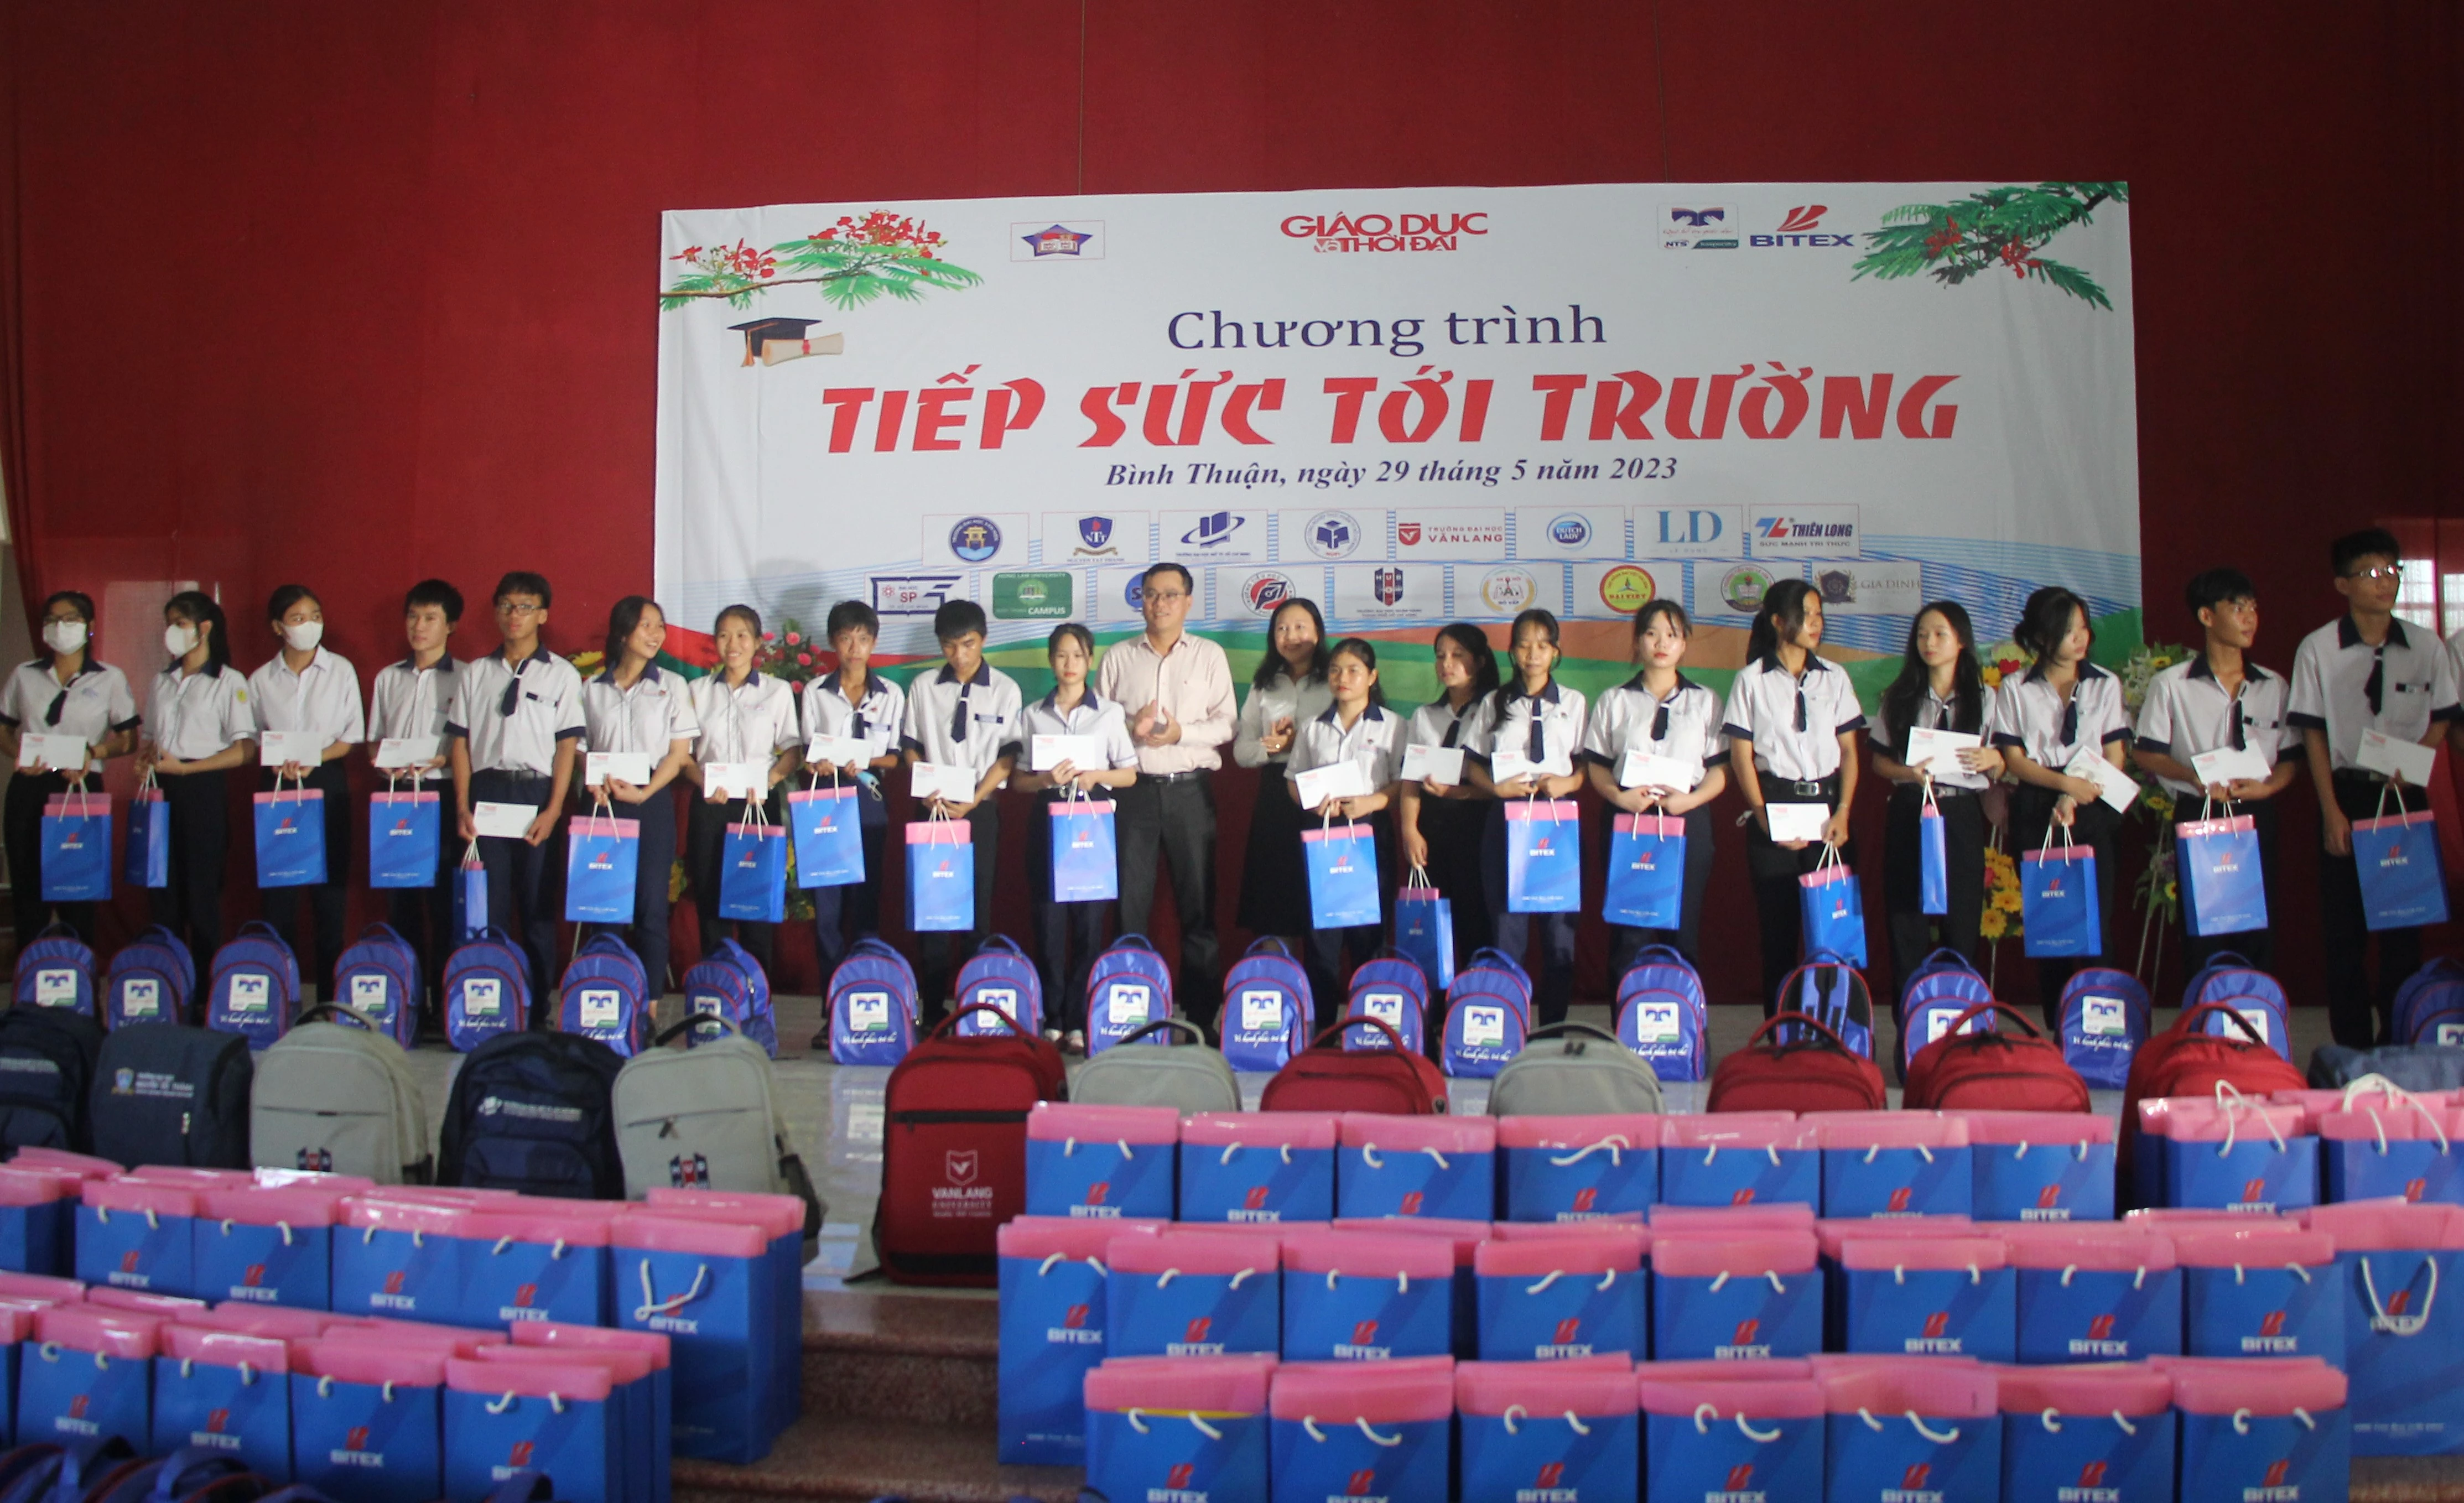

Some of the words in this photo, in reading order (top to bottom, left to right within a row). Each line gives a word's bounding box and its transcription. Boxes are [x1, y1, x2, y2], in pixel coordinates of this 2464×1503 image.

[1281, 211, 1392, 237] GIÁO
[1400, 213, 1488, 237] DỤC
[1750, 235, 1854, 246] BITEX
[1168, 310, 1425, 357] Chương
[1444, 304, 1607, 346] trình
[823, 364, 1046, 453] TIẾP
[1078, 368, 1286, 448] SỨC
[1323, 365, 1494, 444] TỚI
[1532, 361, 1962, 441] TRƯỜNG
[1107, 464, 1173, 485] Bình
[1188, 462, 1286, 490] Thuận,
[1298, 461, 1366, 488] ngày
[1376, 461, 1410, 482] 29
[1418, 460, 1501, 487] tháng
[1511, 459, 1527, 481] 5
[1537, 459, 1599, 480] năm
[1609, 457, 1677, 479] 2023
[1656, 511, 1722, 543] LD
[1791, 522, 1822, 537] THIÊN
[1823, 526, 1852, 537] LONG
[900, 591, 917, 603] SP
[1028, 607, 1065, 615] CAMPUS
[1070, 1205, 1122, 1220] BITEX
[1227, 1209, 1281, 1223] BITEX
[2021, 1208, 2071, 1221] BITEX
[108, 1271, 149, 1288] BITEX
[229, 1285, 278, 1301] BITEX
[370, 1293, 415, 1309] BITEX
[500, 1307, 549, 1322] BITEX
[649, 1317, 698, 1334] BITEX
[1047, 1328, 1102, 1344] BITEX
[1166, 1343, 1224, 1358] BITEX
[1333, 1344, 1390, 1359] BITEX
[1904, 1338, 1962, 1353] BITEX
[2069, 1339, 2128, 1355] BITEX
[2241, 1336, 2297, 1352] BITEX
[1535, 1344, 1593, 1360] BITEX
[1715, 1345, 1771, 1360] BITEX
[55, 1416, 98, 1434] BITEX
[191, 1432, 240, 1449] BITEX
[330, 1449, 383, 1467] BITEX
[1147, 1488, 1208, 1503] BITEX
[1516, 1489, 1577, 1503] BITEX
[1706, 1491, 1765, 1503] BITEX
[1881, 1490, 1943, 1503] BITEX
[2058, 1487, 2119, 1502] BITEX
[2243, 1486, 2299, 1502] BITEX
